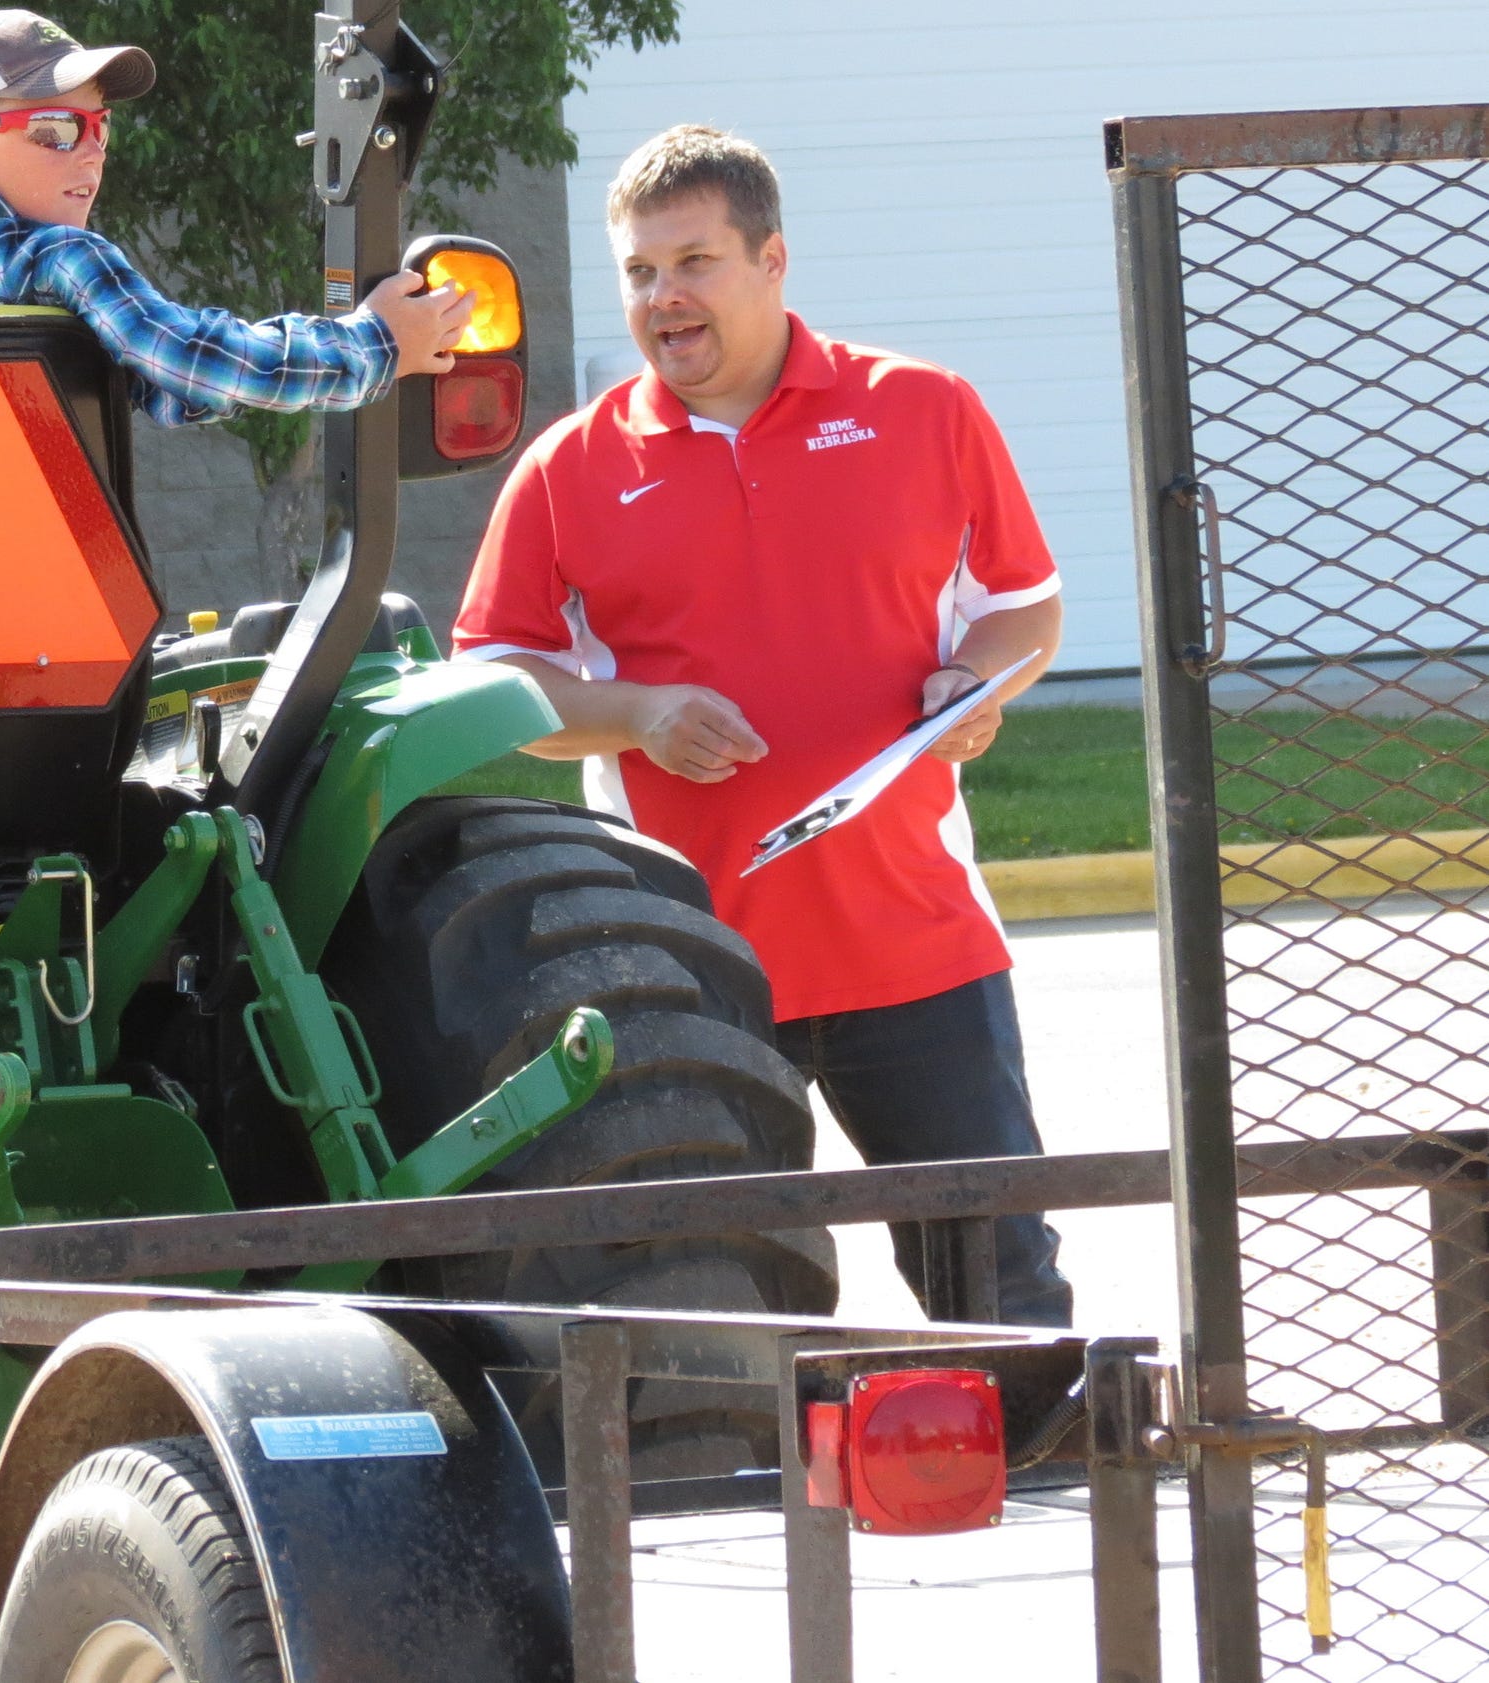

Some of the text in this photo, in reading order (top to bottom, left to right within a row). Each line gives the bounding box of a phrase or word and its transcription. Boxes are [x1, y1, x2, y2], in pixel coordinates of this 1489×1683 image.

[818, 418, 857, 435] UNMC
[805, 427, 877, 452] NEBRASKA
[148, 702, 170, 721] UTION
[375, 1417, 419, 1430] SALES
